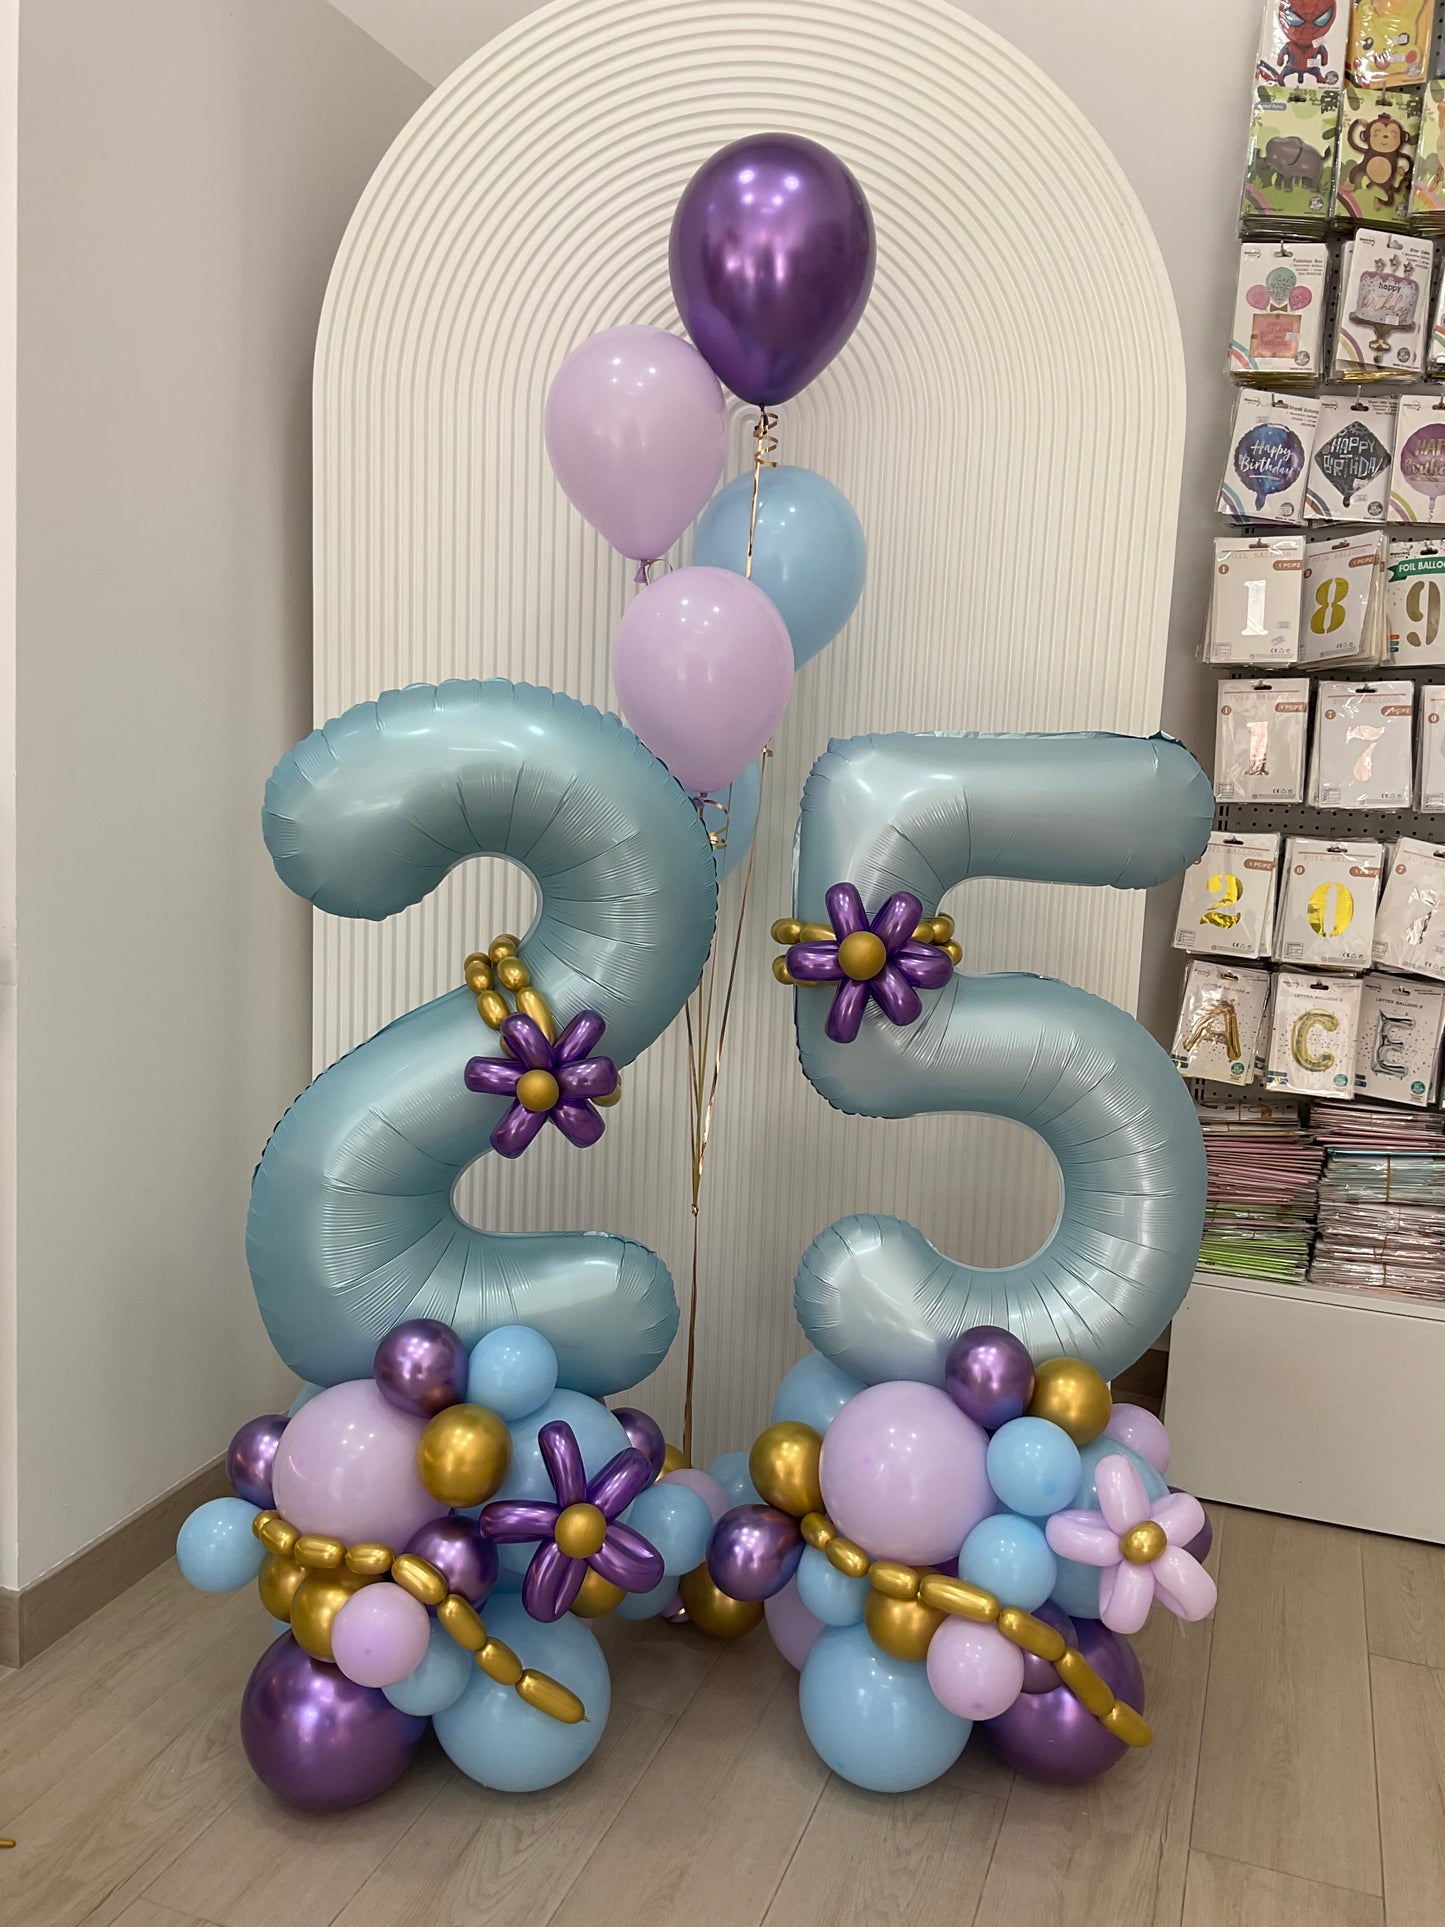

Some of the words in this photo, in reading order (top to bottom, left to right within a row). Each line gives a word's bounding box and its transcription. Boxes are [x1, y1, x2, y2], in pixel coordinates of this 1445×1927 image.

[1361, 289, 1411, 323] birthday
[1378, 281, 1401, 294] happy
[1240, 453, 1294, 480] Birthday
[1250, 439, 1293, 462] Happy
[1330, 436, 1375, 454] HAPPY
[1398, 563, 1416, 573] FOIL
[1418, 560, 1445, 570] BALLO
[1241, 579, 1269, 636] 1
[1310, 577, 1350, 635] 8
[1406, 580, 1441, 647] 9
[1244, 721, 1269, 776] 1
[1345, 725, 1385, 781] 7
[1200, 873, 1244, 929] 2
[1307, 881, 1355, 938] 0
[1183, 997, 1241, 1063] A
[1291, 1007, 1340, 1073] C
[1370, 1007, 1416, 1080] E
